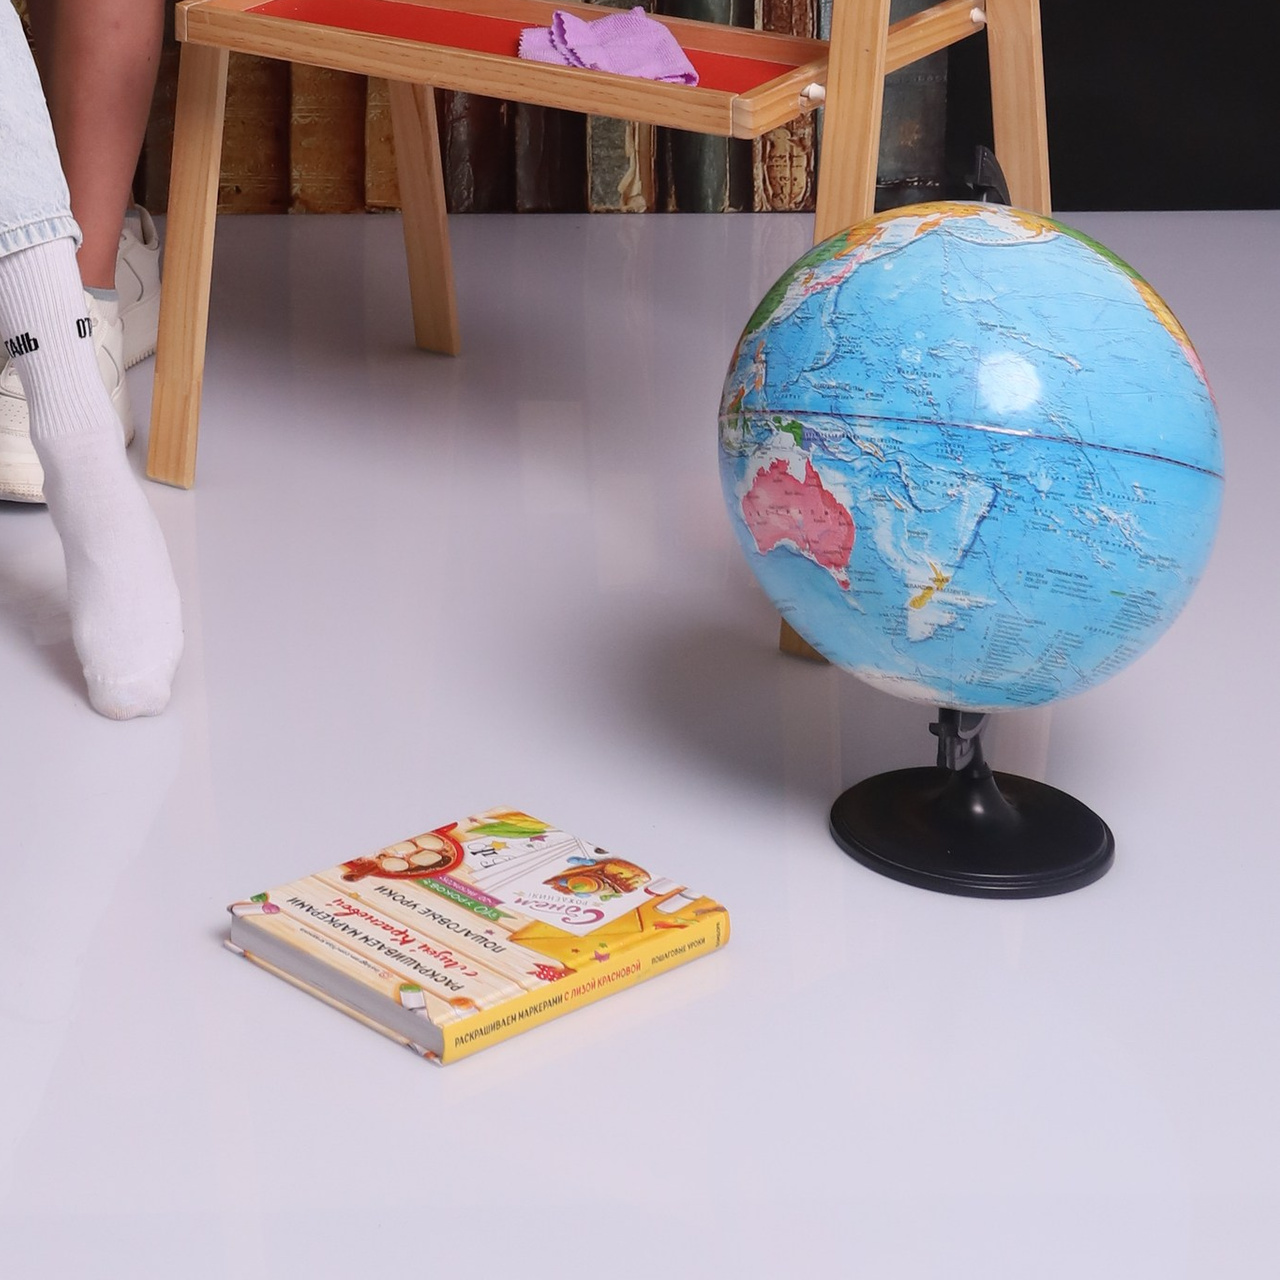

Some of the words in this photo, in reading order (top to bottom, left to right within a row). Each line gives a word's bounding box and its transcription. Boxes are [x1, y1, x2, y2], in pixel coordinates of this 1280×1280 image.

[286, 896, 362, 939] МАРКЕРАМИ
[373, 885, 420, 910] УРОКИ
[325, 897, 417, 946] Красновой
[418, 907, 508, 954] ПОШАГОВЫЕ
[362, 934, 465, 992] РАСКРАШИВАЕМ
[651, 944, 687, 966] ПОШАГОВЫЕ
[686, 937, 707, 951] УРОКИ
[454, 1013, 518, 1048] РАСКРАШИВАЕМ
[517, 994, 564, 1021] МАРКЕРАМИ
[563, 990, 571, 1002] С
[570, 979, 596, 1000] ЛИЗОЙ
[596, 959, 642, 988] КРАСНОВОЙ
